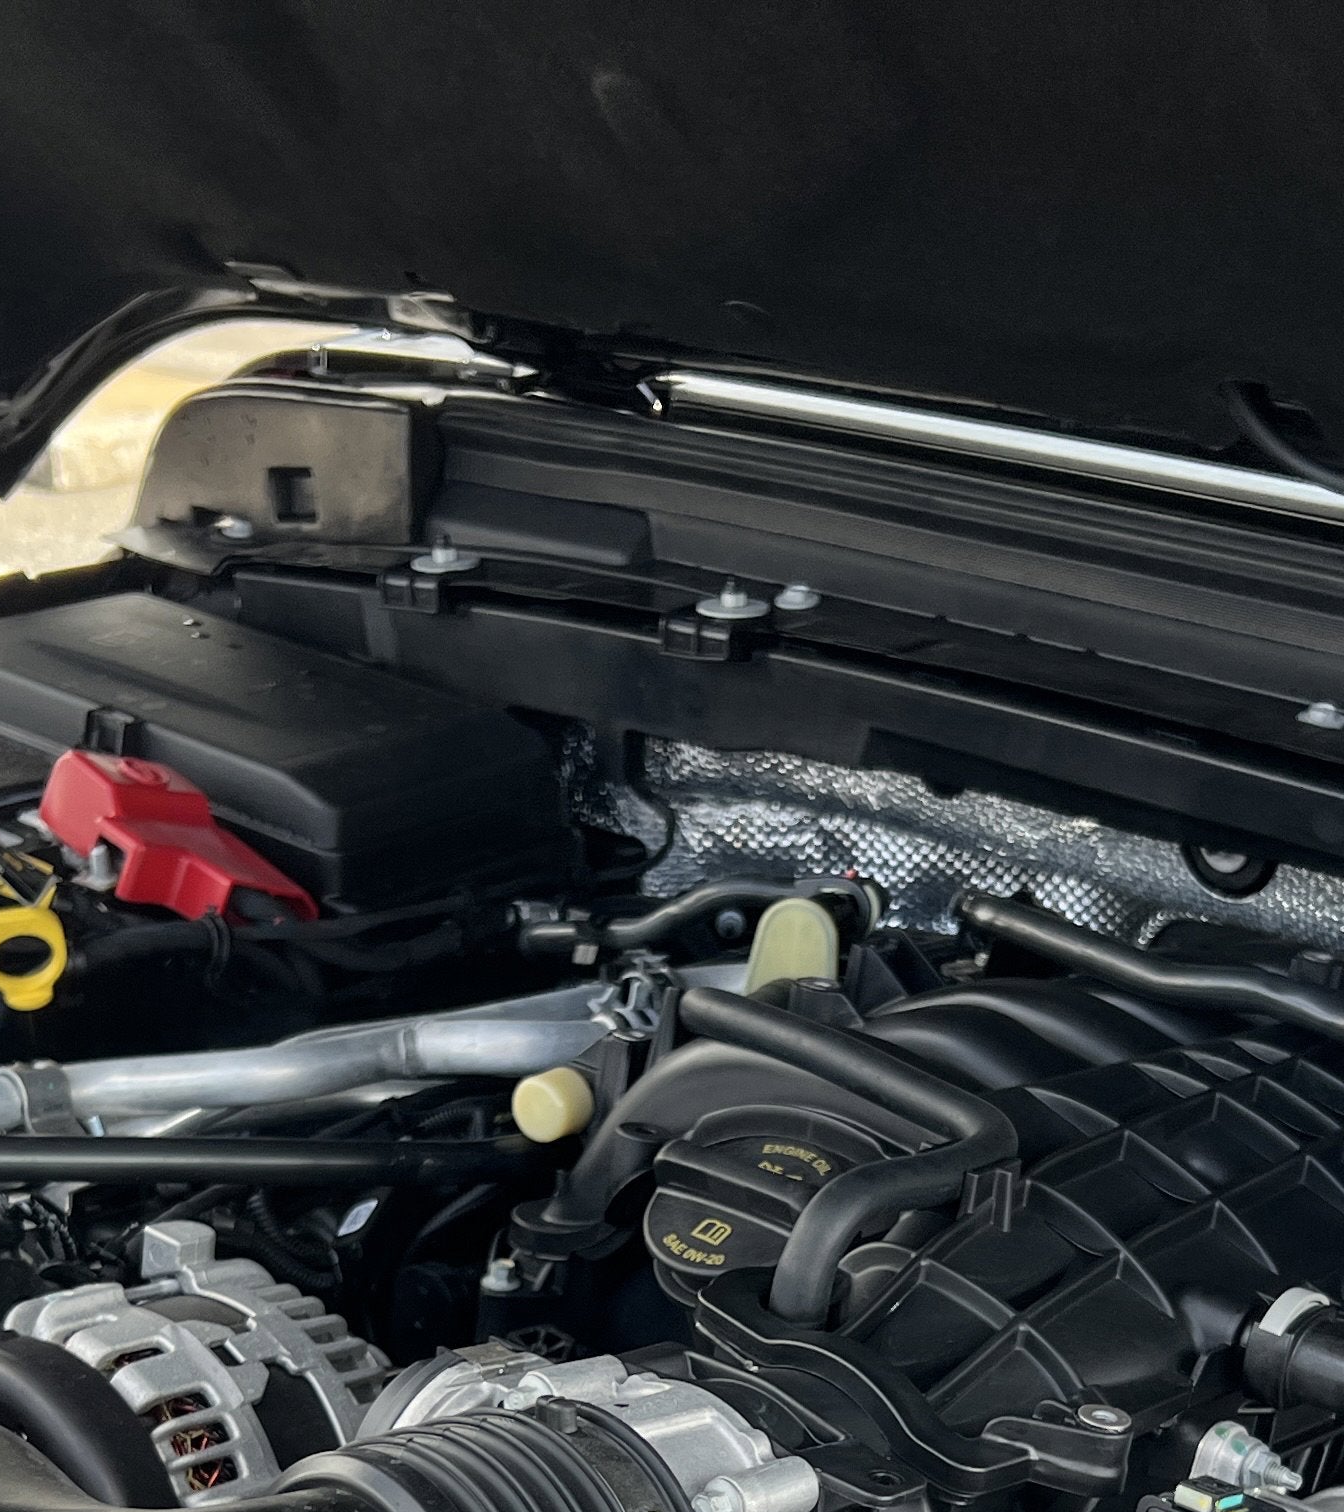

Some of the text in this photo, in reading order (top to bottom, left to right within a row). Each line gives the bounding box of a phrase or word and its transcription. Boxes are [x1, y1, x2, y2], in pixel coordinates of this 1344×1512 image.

[762, 1144, 832, 1177] ENGINE OIL
[662, 1233, 726, 1266] SAE 0W-20
